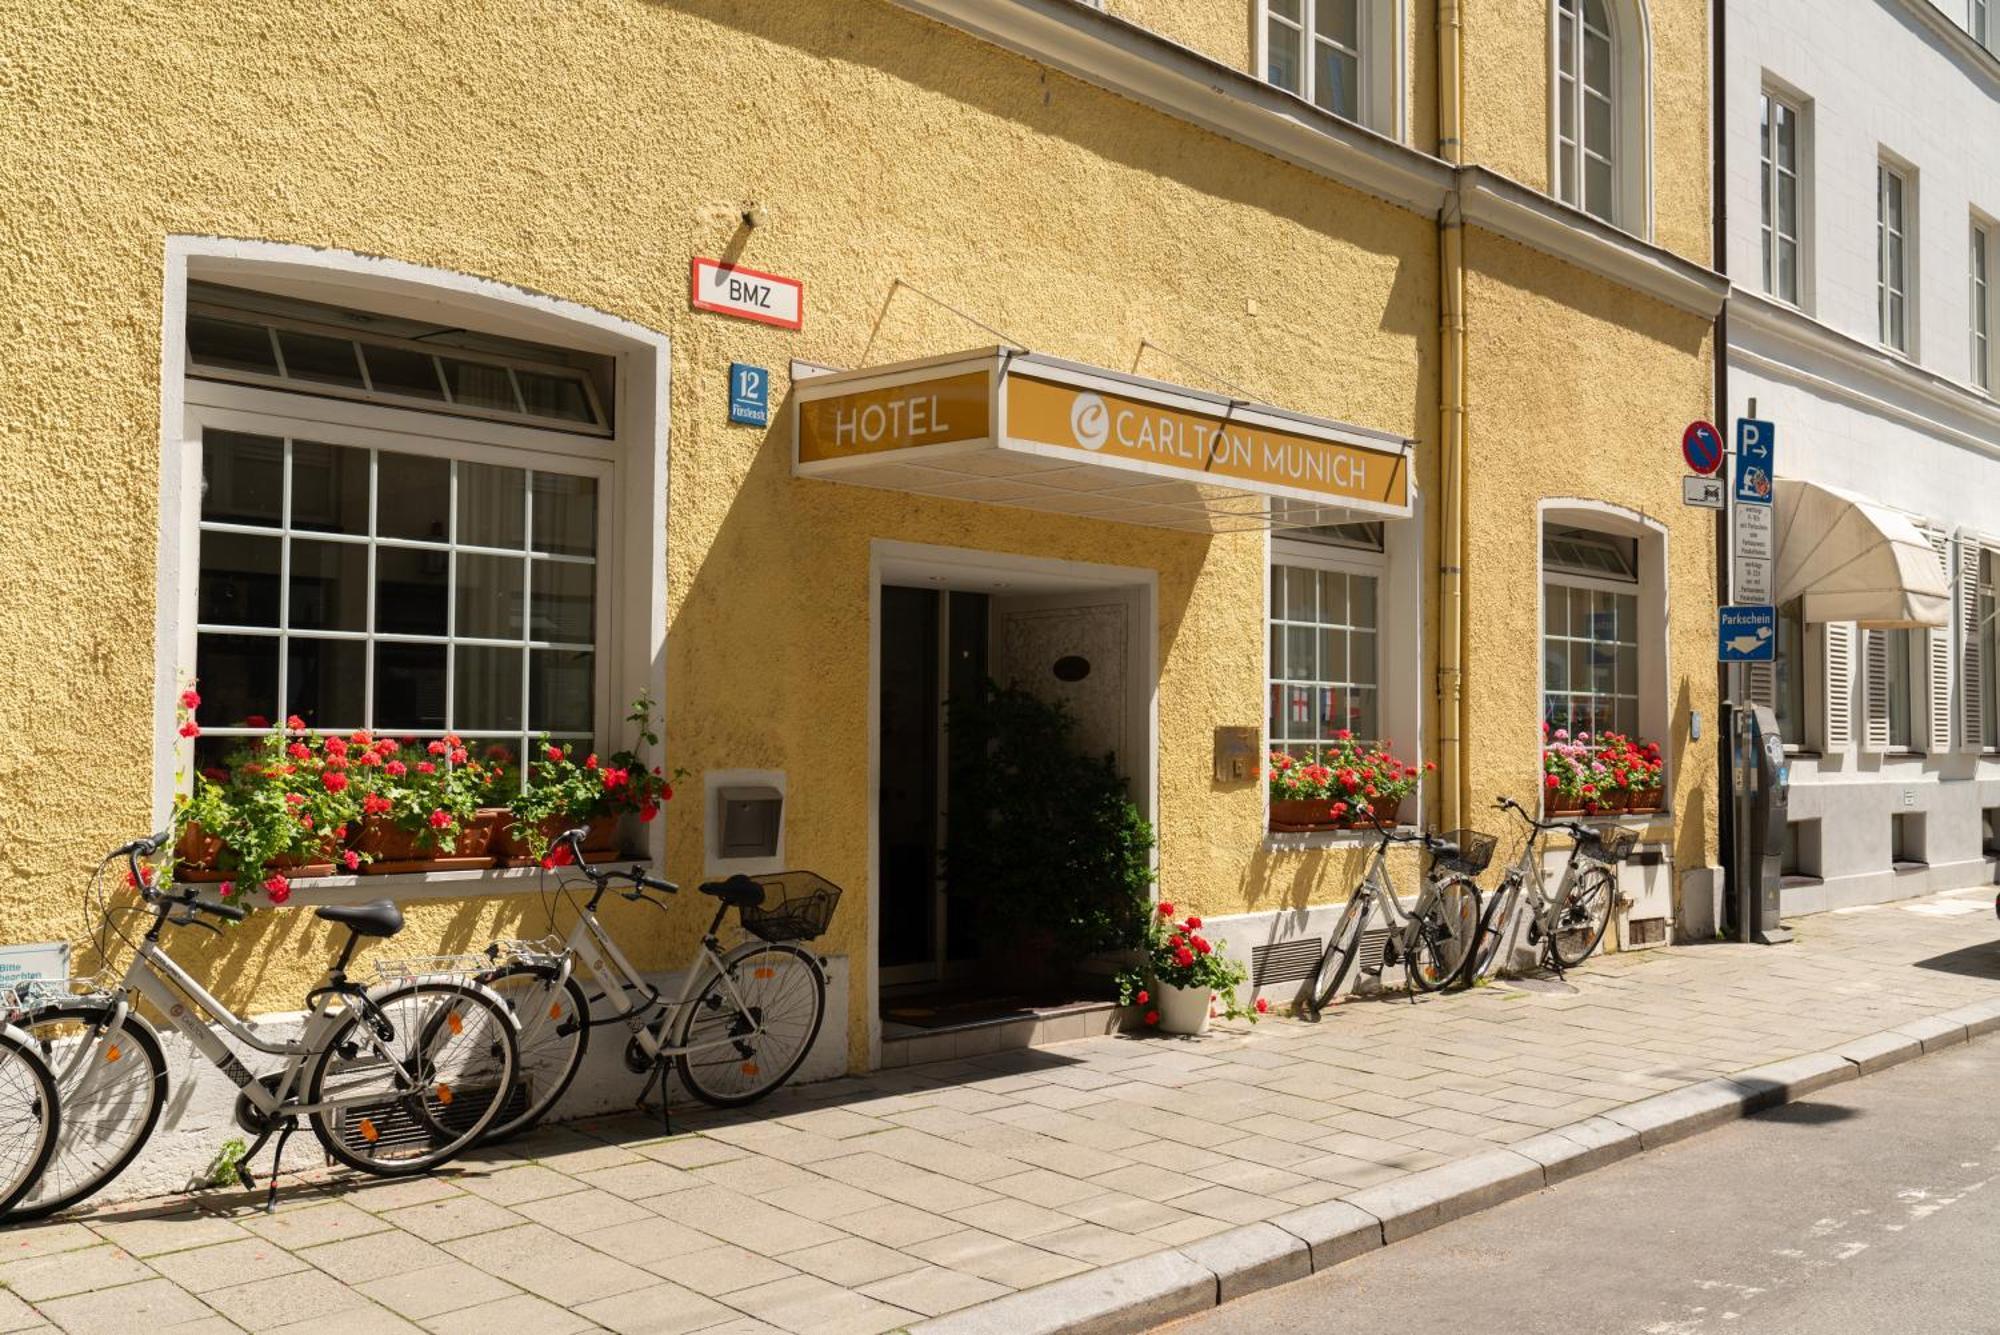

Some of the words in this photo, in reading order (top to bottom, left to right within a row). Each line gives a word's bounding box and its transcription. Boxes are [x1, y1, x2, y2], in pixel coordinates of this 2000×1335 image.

[729, 279, 771, 309] BMZ
[740, 370, 760, 399] 12
[835, 394, 949, 446] HOTEL
[1115, 410, 1252, 468] CARLTON
[1263, 443, 1366, 490] MUNICH
[1742, 424, 1760, 456] P
[1722, 611, 1771, 625] Parkschein
